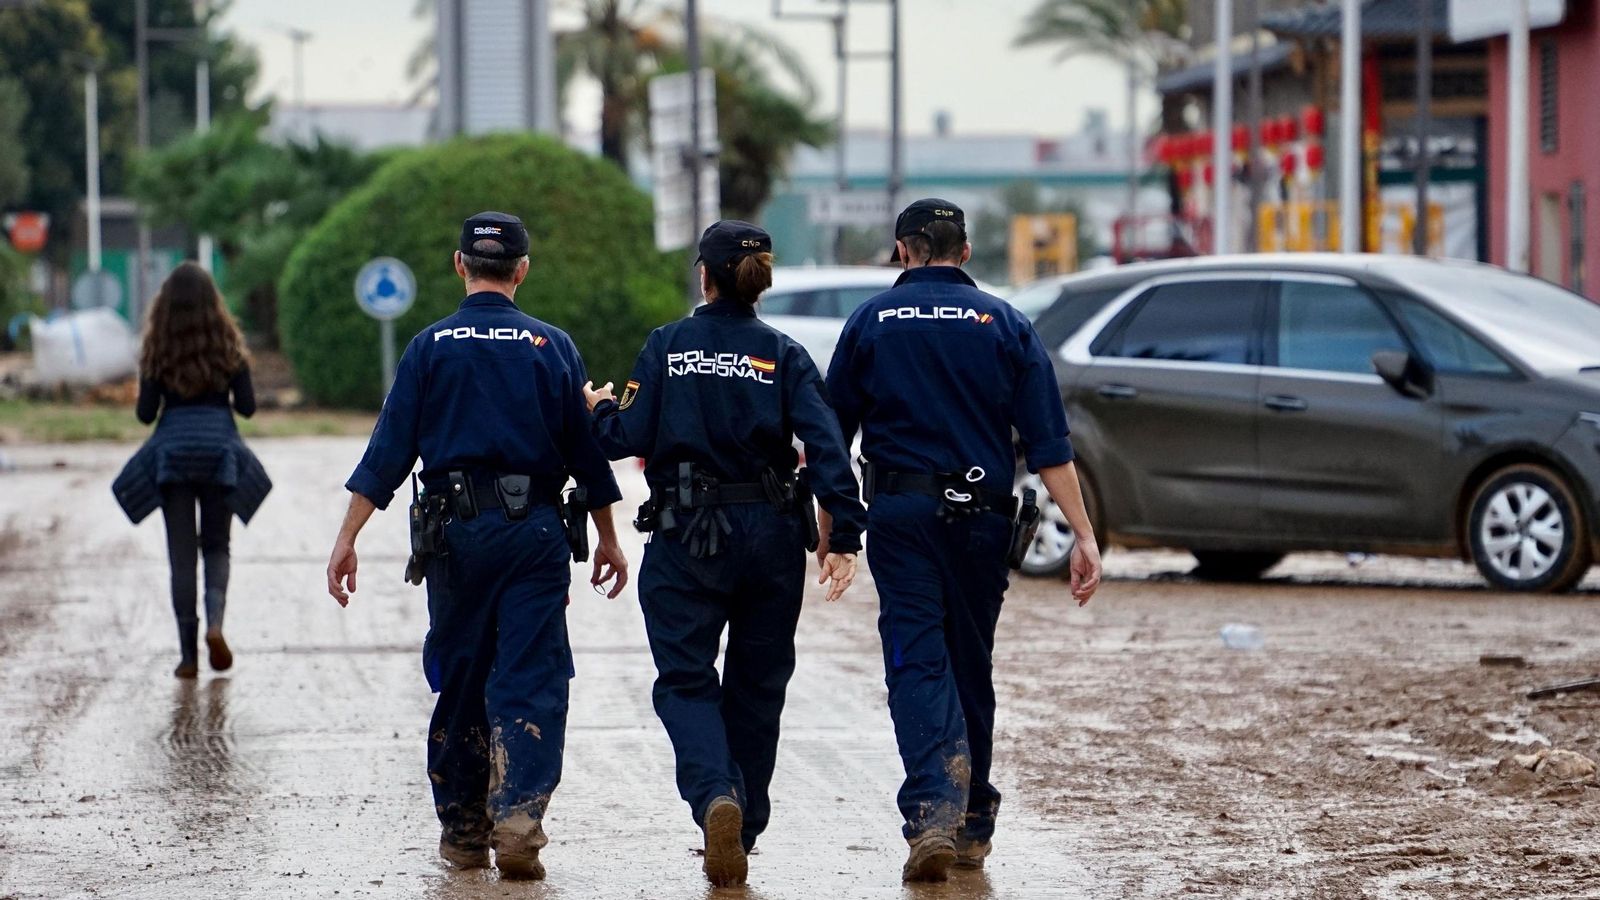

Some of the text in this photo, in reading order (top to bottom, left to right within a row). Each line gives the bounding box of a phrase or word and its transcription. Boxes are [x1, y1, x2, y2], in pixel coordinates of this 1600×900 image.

[935, 209, 954, 217] CNP
[741, 240, 761, 248] CNP
[878, 306, 980, 323] POLICIA
[434, 327, 534, 342] POLICIA
[667, 350, 753, 368] POLICIA
[668, 362, 774, 385] NACIONAL
